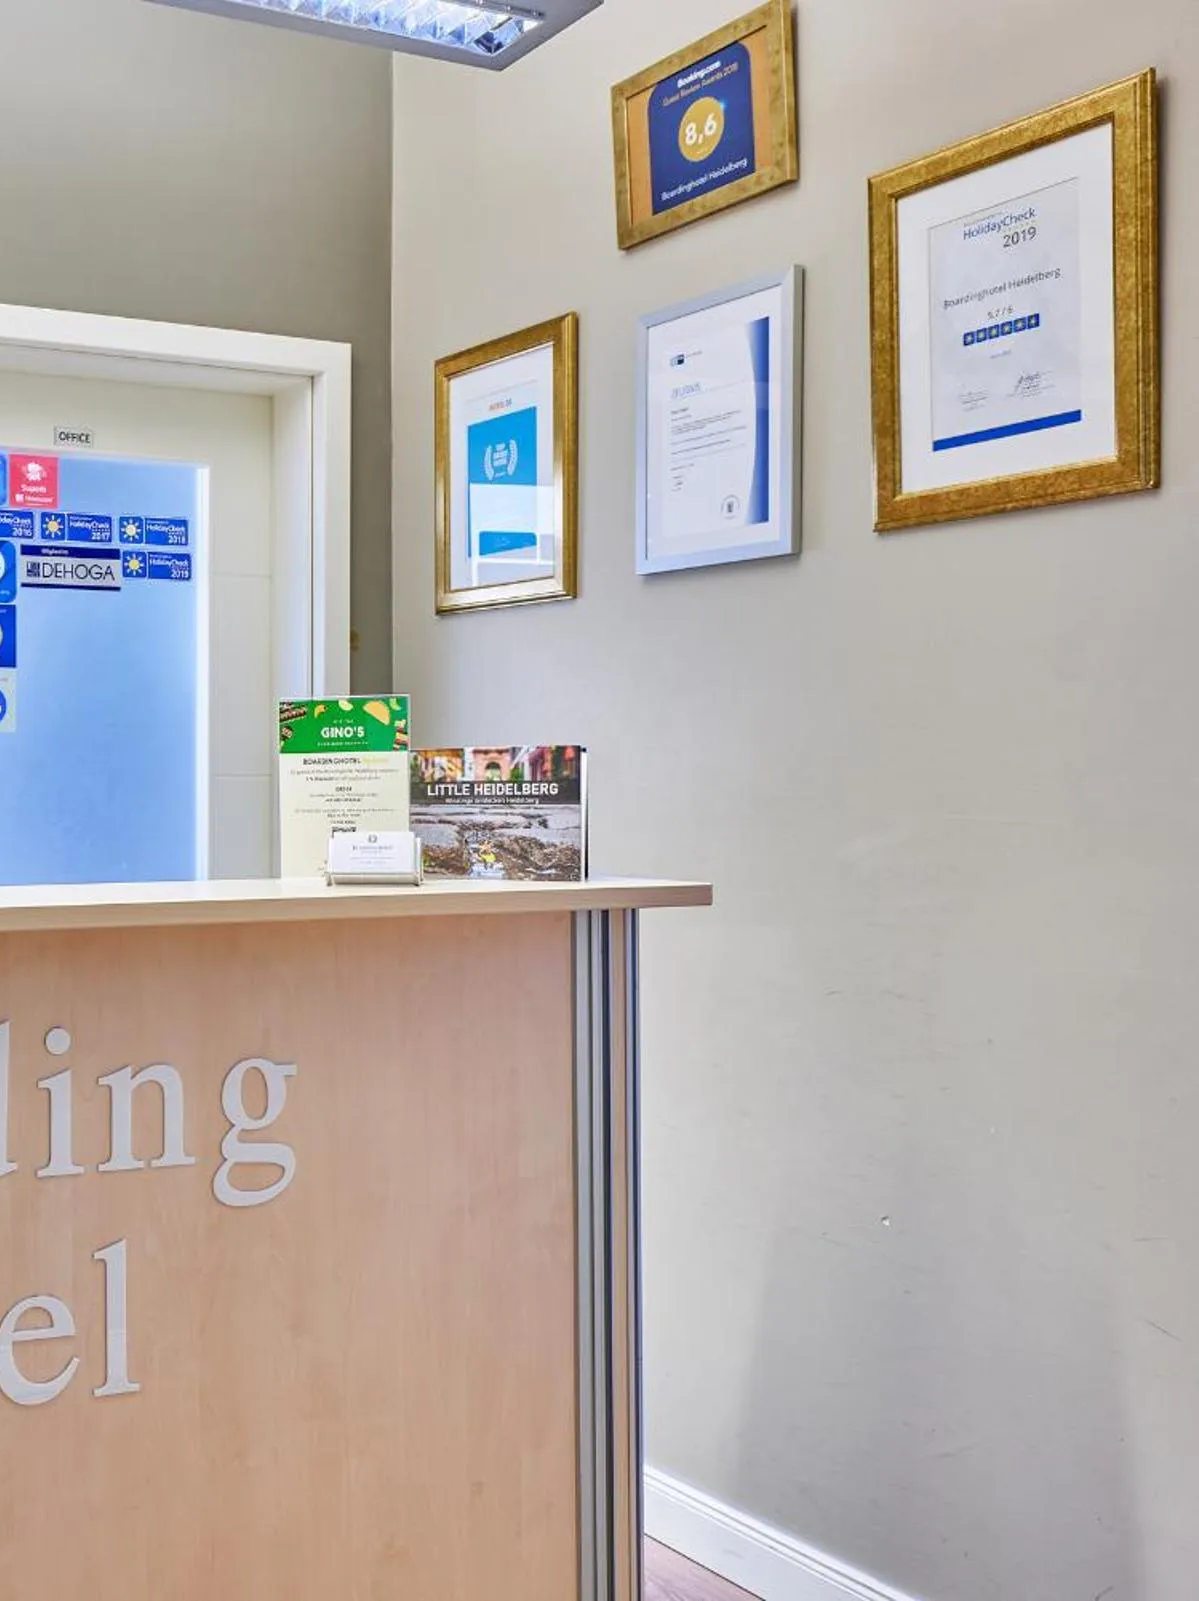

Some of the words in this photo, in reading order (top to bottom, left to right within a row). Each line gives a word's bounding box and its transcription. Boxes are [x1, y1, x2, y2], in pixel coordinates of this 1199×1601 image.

[685, 112, 717, 146] 8,6
[709, 157, 748, 179] Heidelberg
[963, 207, 1037, 240] HolidayCheck
[1003, 225, 1038, 249] 2019
[1008, 267, 1062, 290] Heidelberg
[58, 431, 91, 444] OFFICE
[42, 561, 116, 581] DEHOGA
[320, 726, 365, 739] GINO'S
[427, 784, 470, 796] LITTLE
[474, 782, 559, 796] HEIDELBERG
